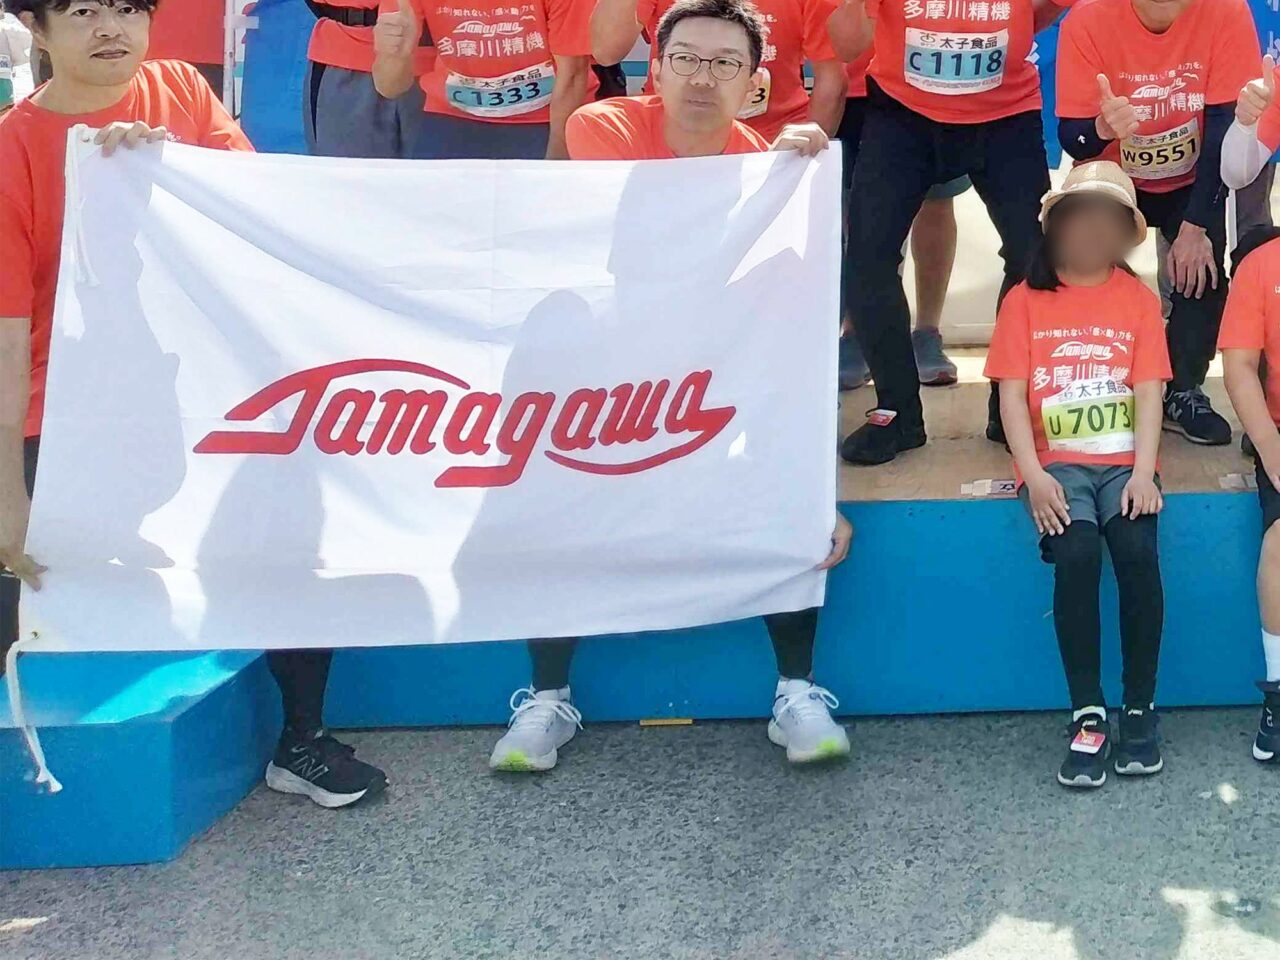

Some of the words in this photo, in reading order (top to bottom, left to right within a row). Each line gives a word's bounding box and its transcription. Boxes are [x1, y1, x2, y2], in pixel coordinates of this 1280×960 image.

[437, 31, 545, 58] 多摩川精機
[939, 35, 998, 50] 太子食品
[909, 49, 1003, 77] C1118
[1122, 138, 1197, 167] W9551
[1076, 379, 1127, 399] 太子食品
[192, 358, 737, 488] Tamagawa
